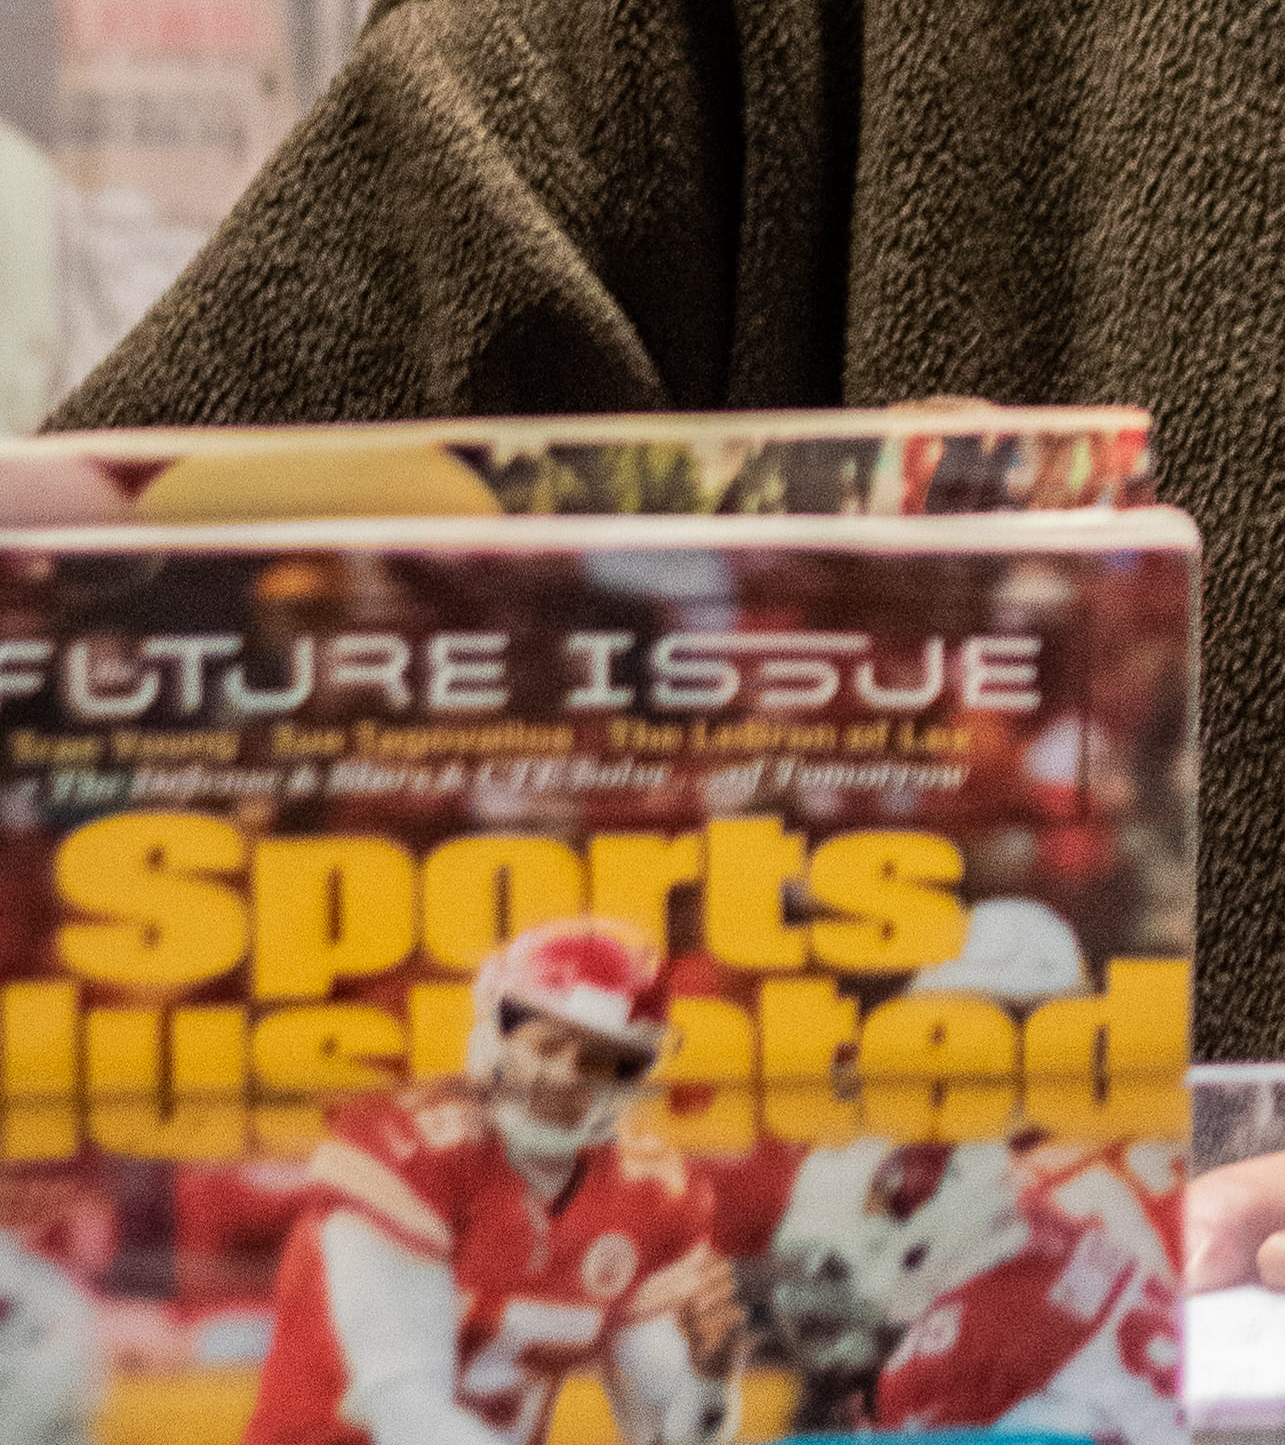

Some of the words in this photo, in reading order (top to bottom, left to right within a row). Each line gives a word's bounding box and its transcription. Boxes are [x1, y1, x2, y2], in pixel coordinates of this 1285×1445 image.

[0, 631, 512, 715] FUTURE
[563, 630, 1045, 713] ISSUE
[54, 811, 968, 1001] Sports
